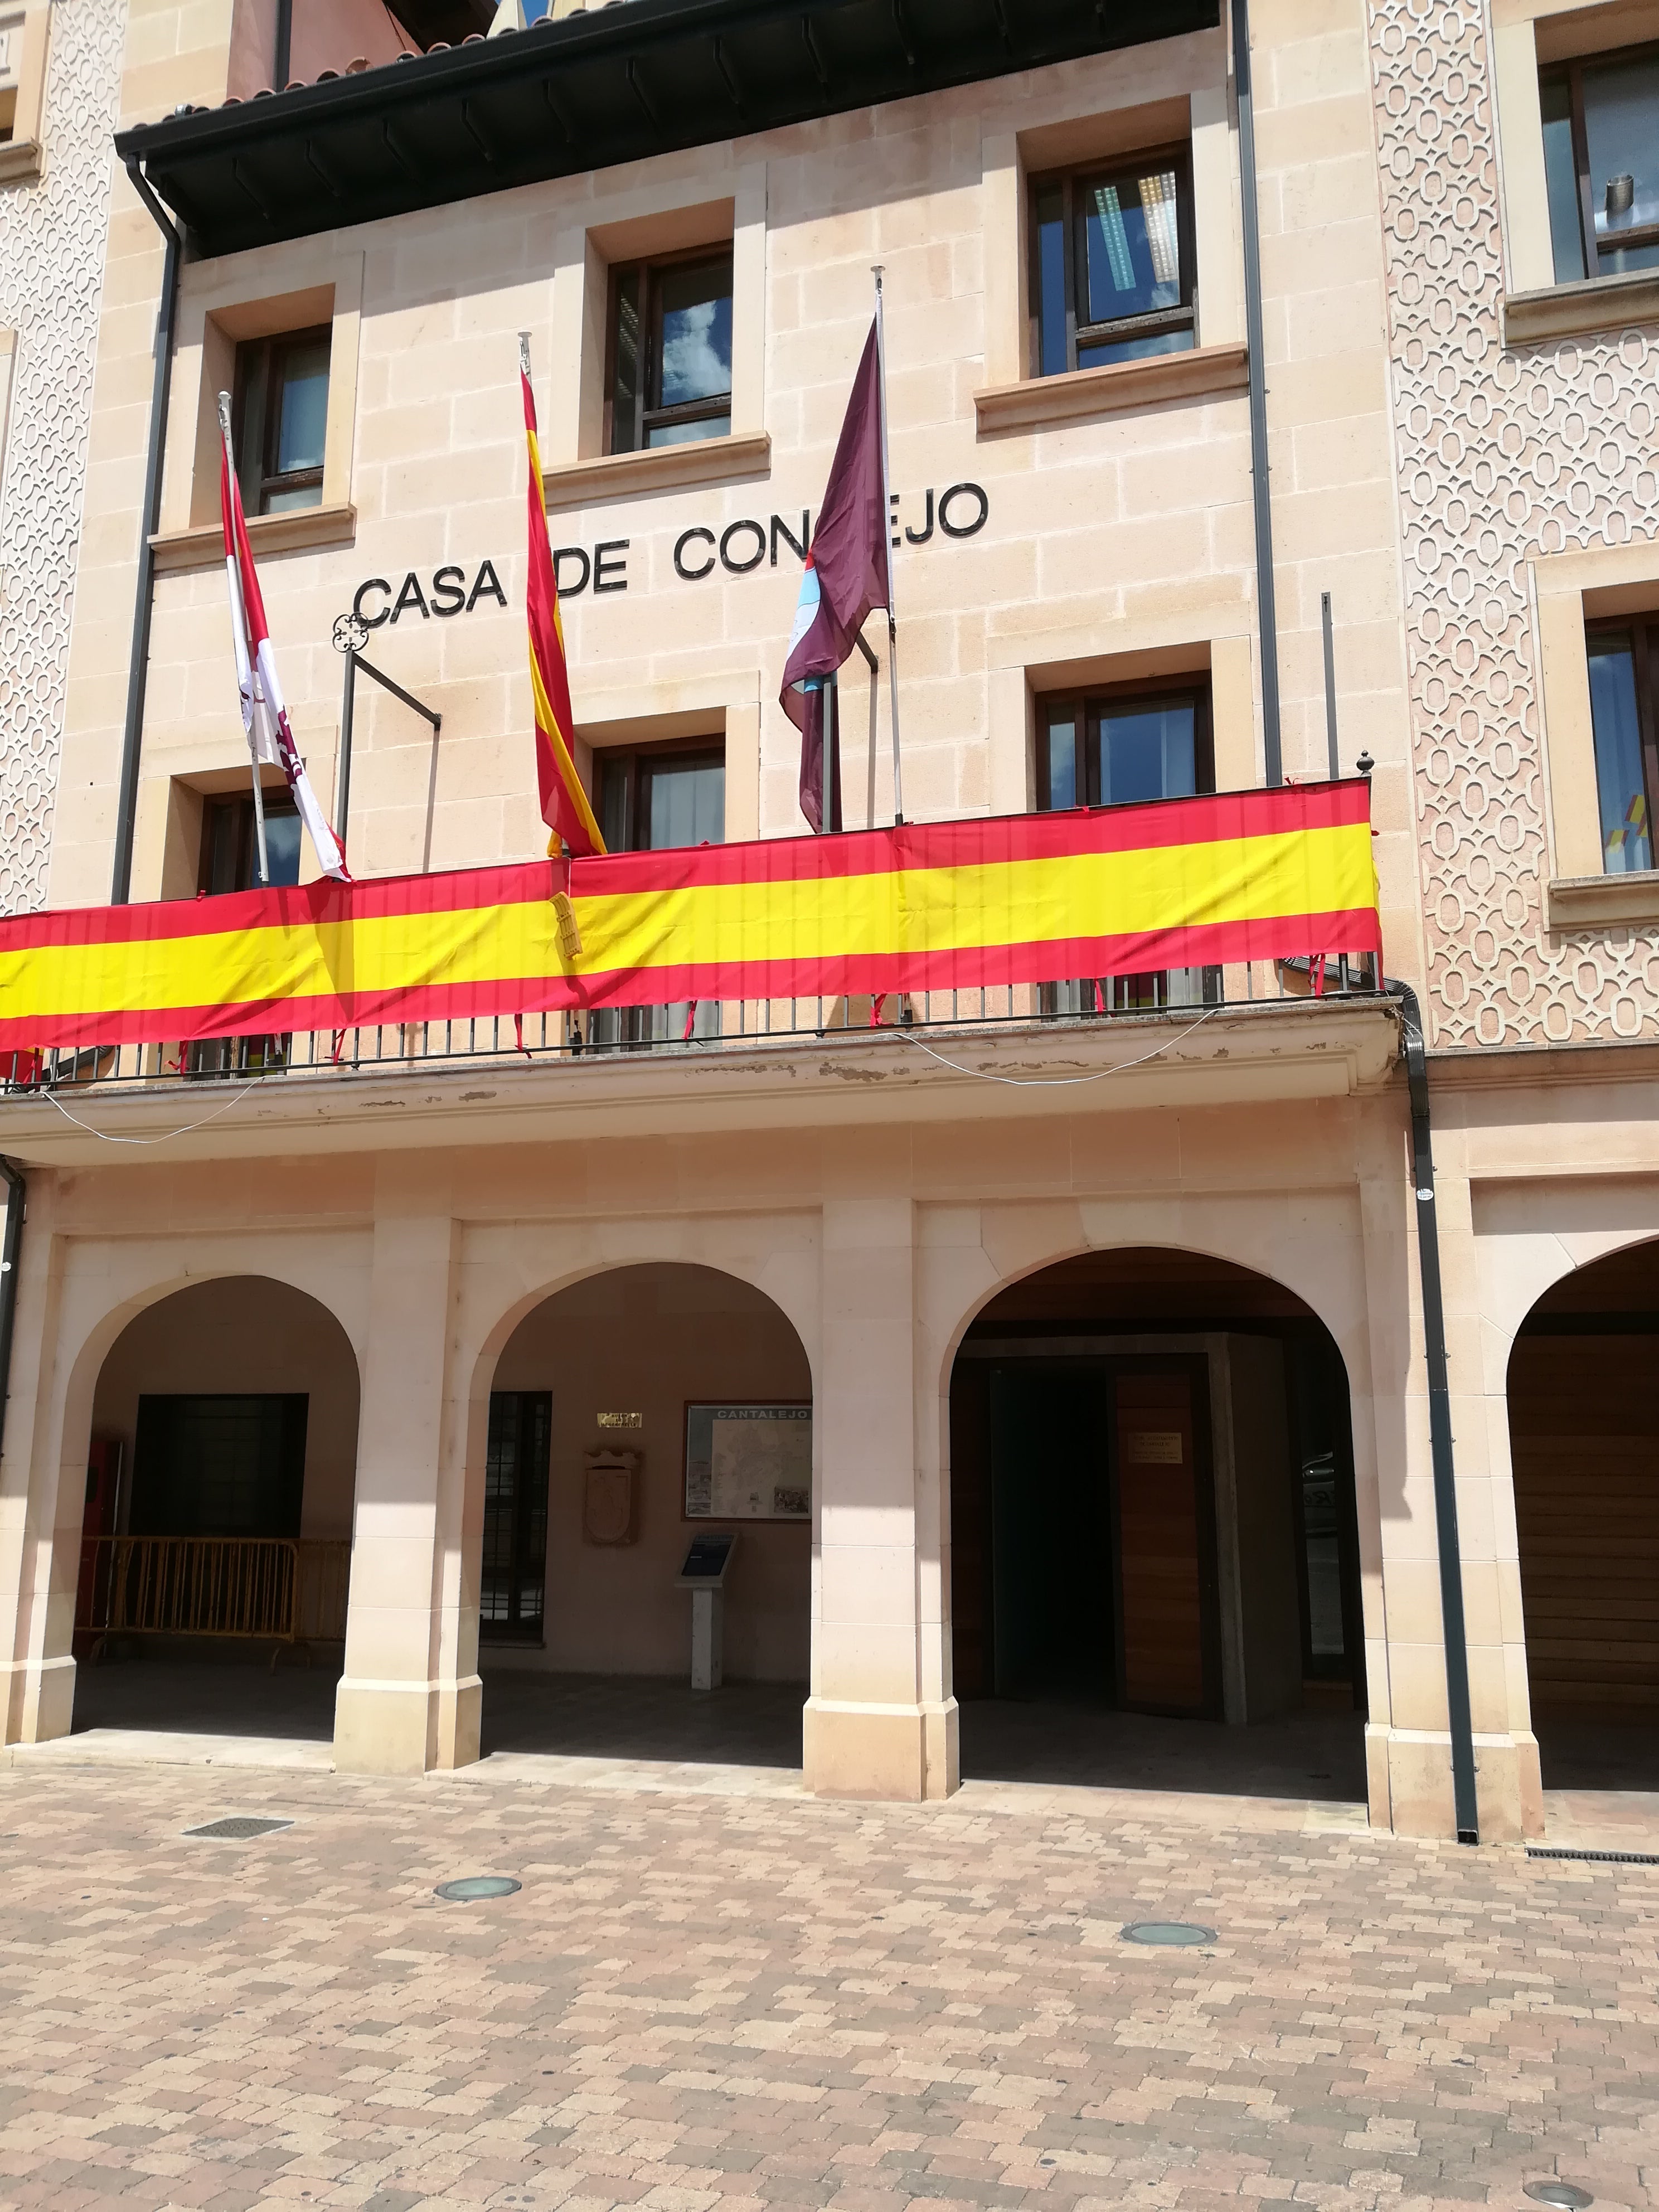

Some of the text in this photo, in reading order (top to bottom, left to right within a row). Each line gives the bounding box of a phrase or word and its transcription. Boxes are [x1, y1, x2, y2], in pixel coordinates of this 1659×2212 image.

[353, 483, 989, 629] CASA DE CONEJO
[717, 1410, 808, 1419] CANTALEJO
